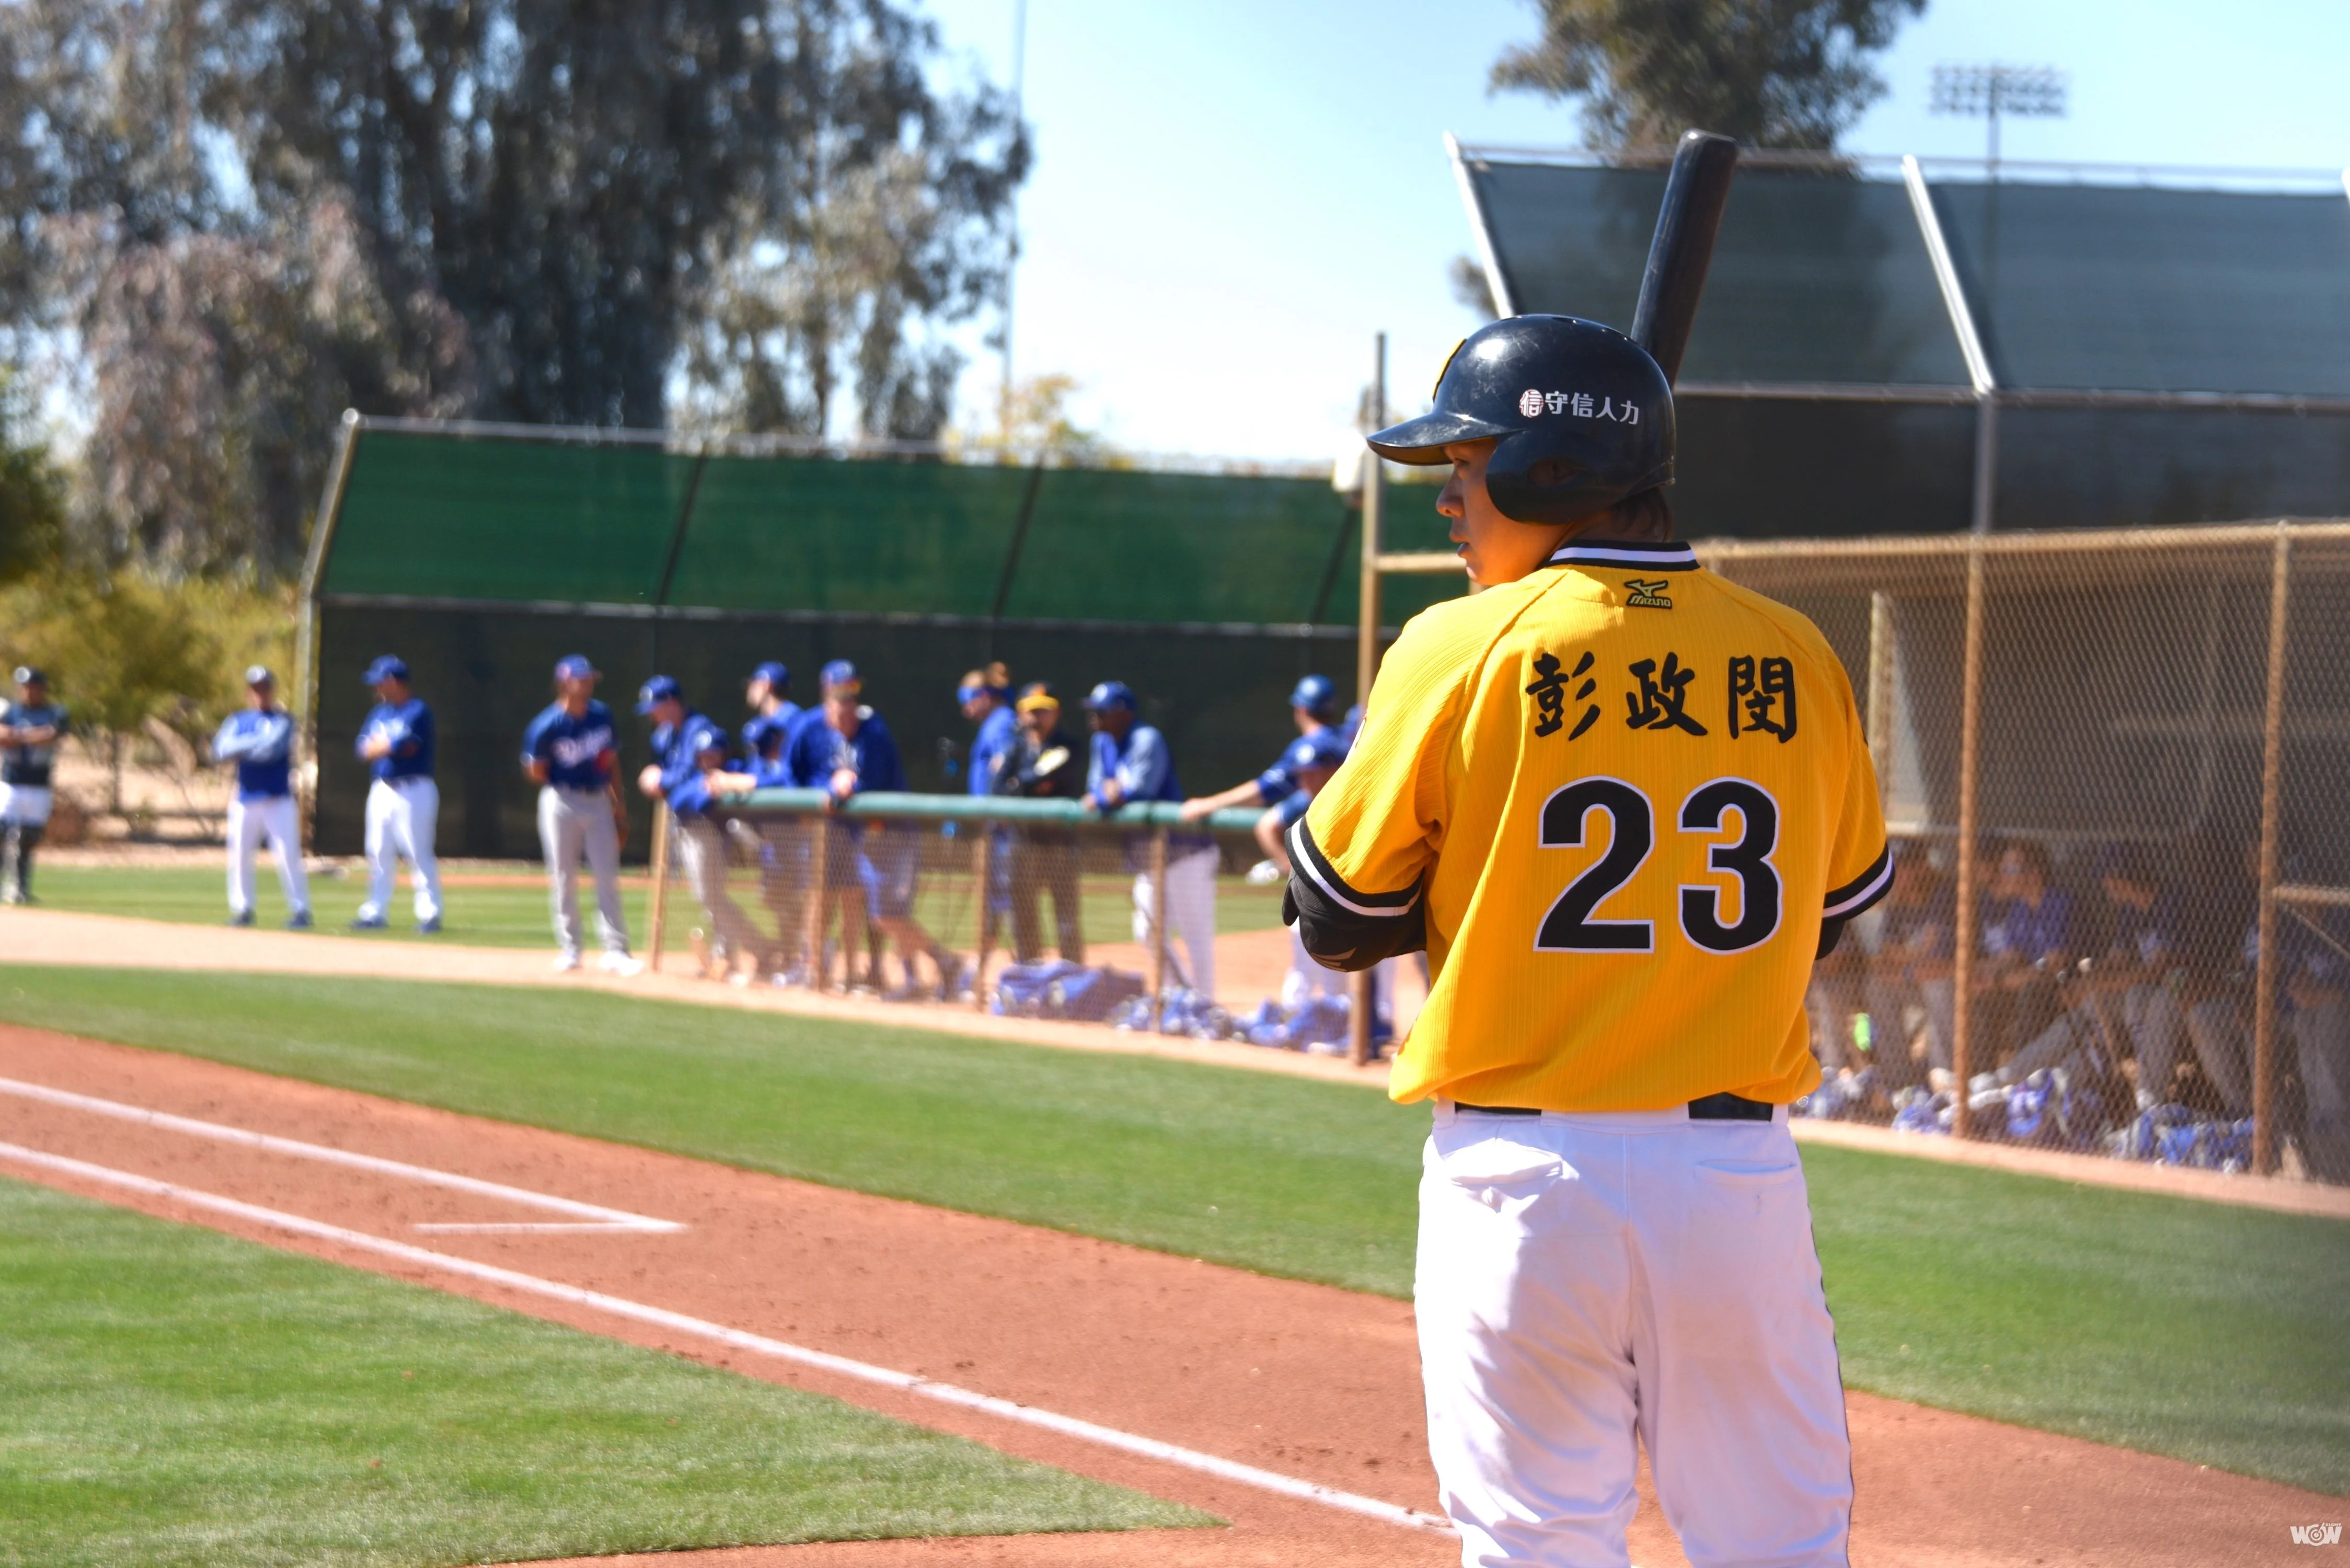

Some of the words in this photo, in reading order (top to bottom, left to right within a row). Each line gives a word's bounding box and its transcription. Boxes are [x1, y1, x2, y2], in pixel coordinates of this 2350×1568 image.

[1545, 390, 1639, 425] 守信人力
[1525, 651, 1798, 744] 彭政閔
[1533, 775, 1784, 955] 23
